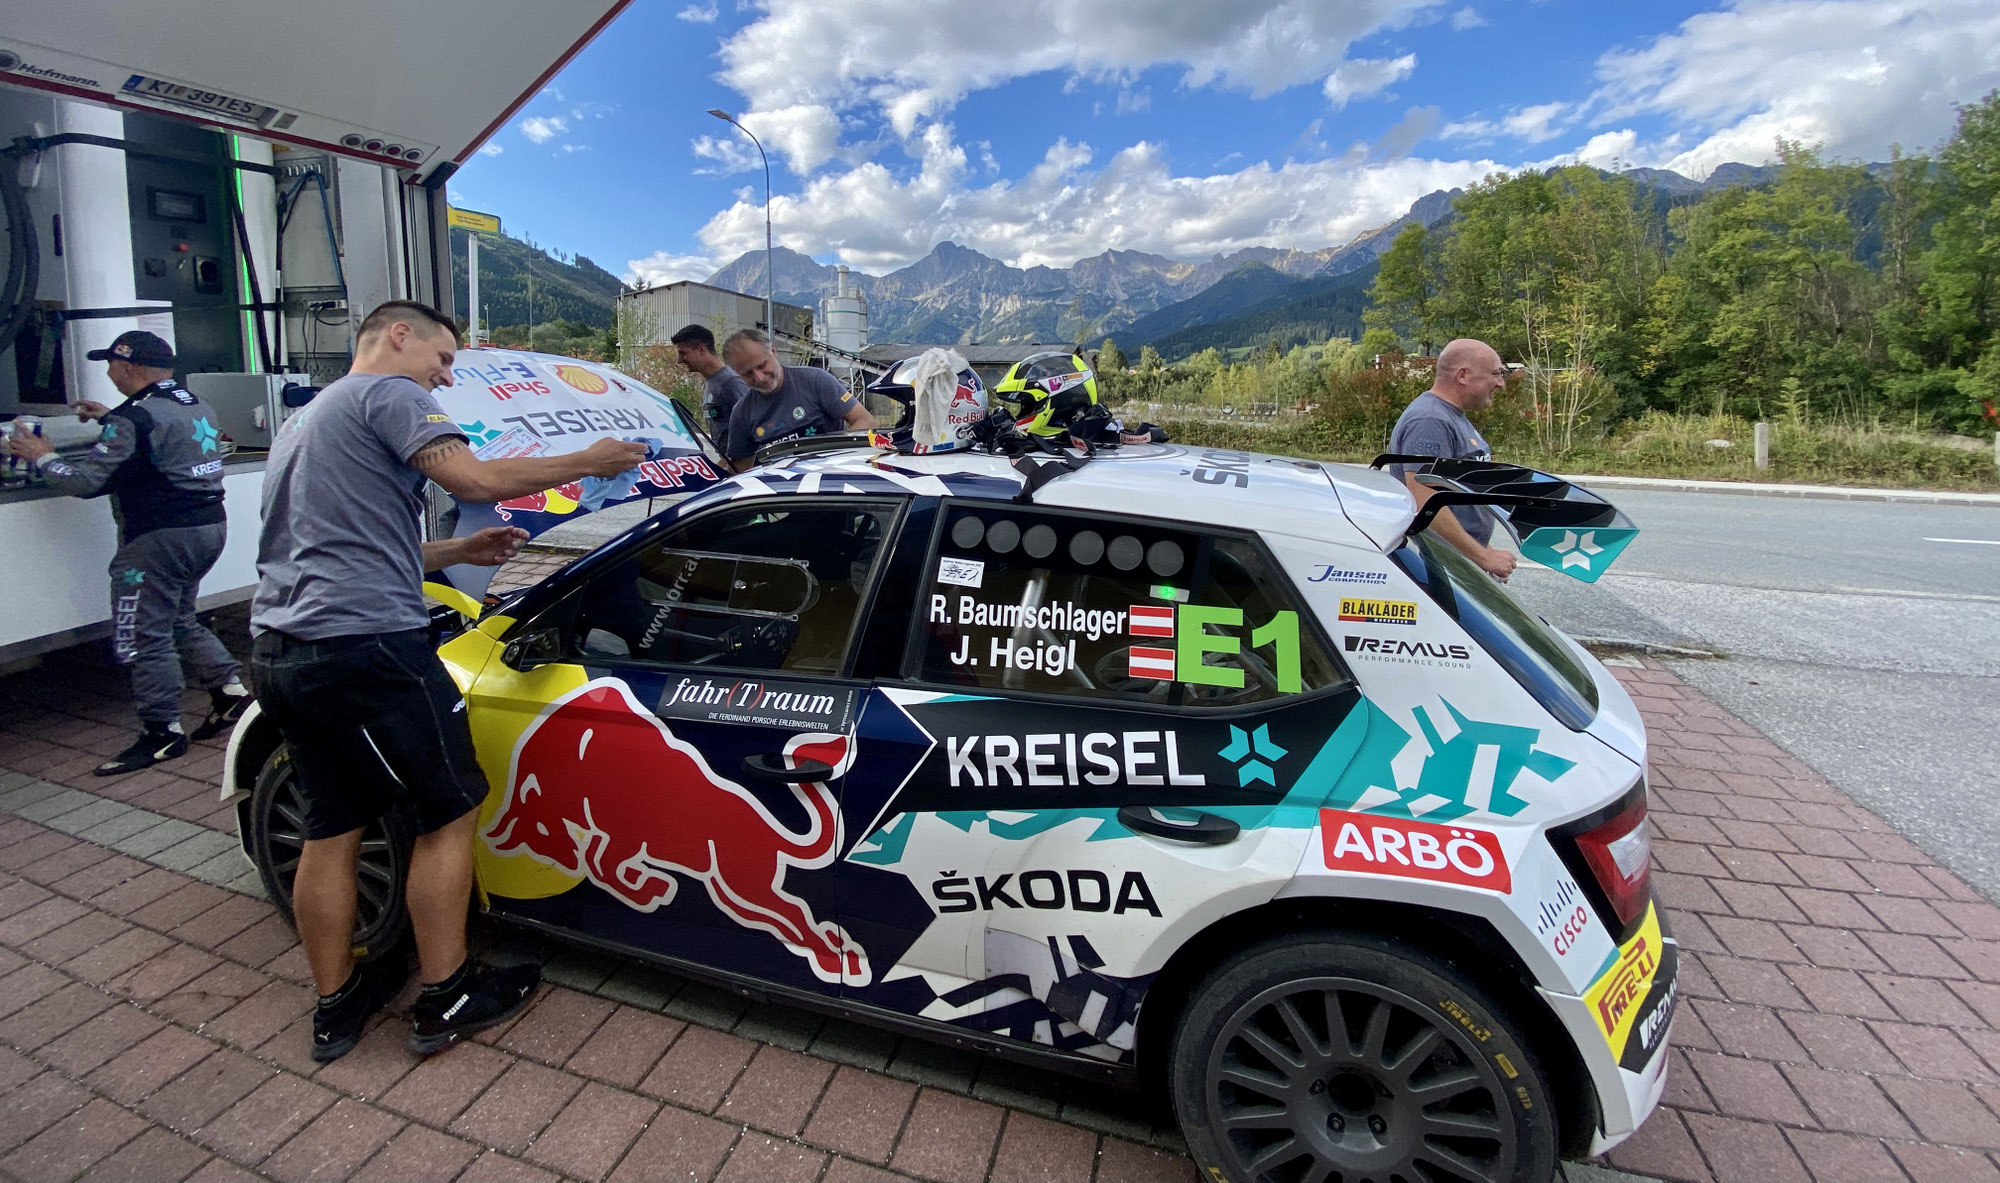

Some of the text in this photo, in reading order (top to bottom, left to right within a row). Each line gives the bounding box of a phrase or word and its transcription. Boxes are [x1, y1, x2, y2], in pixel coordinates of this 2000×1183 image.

[437, 361, 537, 392] E-Flu
[487, 380, 551, 401] Shell
[502, 407, 654, 439] KREISEL
[949, 409, 986, 425] Red Bull
[191, 459, 223, 477] KREISE
[1180, 449, 1251, 488] ŠKO
[1307, 564, 1388, 583] Jansen
[1328, 577, 1387, 585] COMPETITION
[638, 555, 700, 649] wwworr.a
[930, 594, 1127, 642] R. Baumschlager
[1342, 600, 1415, 618] BLÅKLÄDER
[950, 635, 1076, 677] J. Heigl
[1177, 603, 1302, 694] E1
[1358, 637, 1471, 660] REMUS
[1358, 654, 1472, 669] PERFORMANCE SOUND
[665, 677, 835, 716] fahr(T)raum
[708, 712, 830, 731] DIE FERDINAND PORSCHE ERLEBNISWELTEN
[946, 729, 1206, 788] KREISEL
[1333, 822, 1495, 877] ARBÖ
[932, 868, 1164, 918] ŠKODA
[1597, 936, 1655, 1038] PIRELLI
[1438, 999, 1492, 1043] PIRELLI
